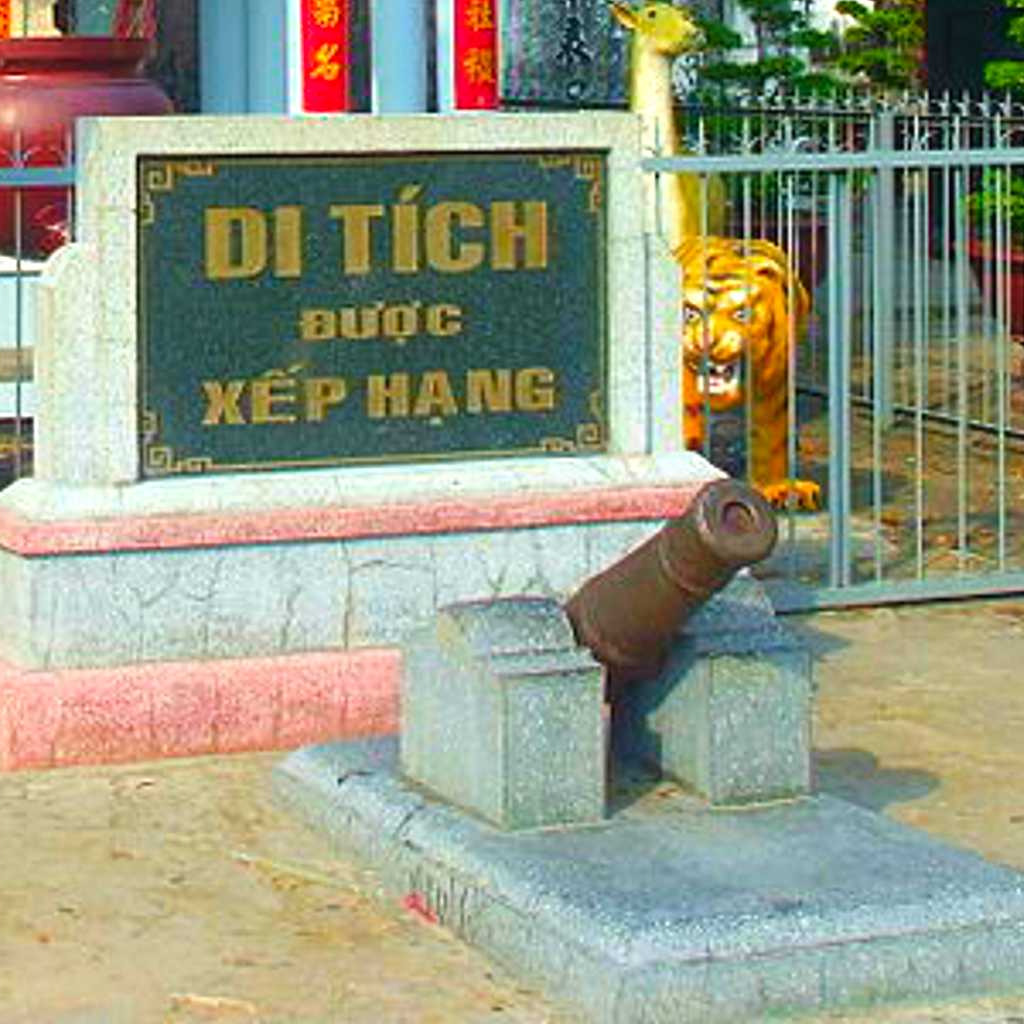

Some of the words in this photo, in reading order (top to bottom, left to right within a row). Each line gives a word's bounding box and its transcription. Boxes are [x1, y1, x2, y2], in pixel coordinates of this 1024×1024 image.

[204, 204, 302, 279] DI
[329, 184, 548, 275] TÍCH
[201, 360, 347, 426] XẾP
[366, 367, 556, 425] HẠNG
